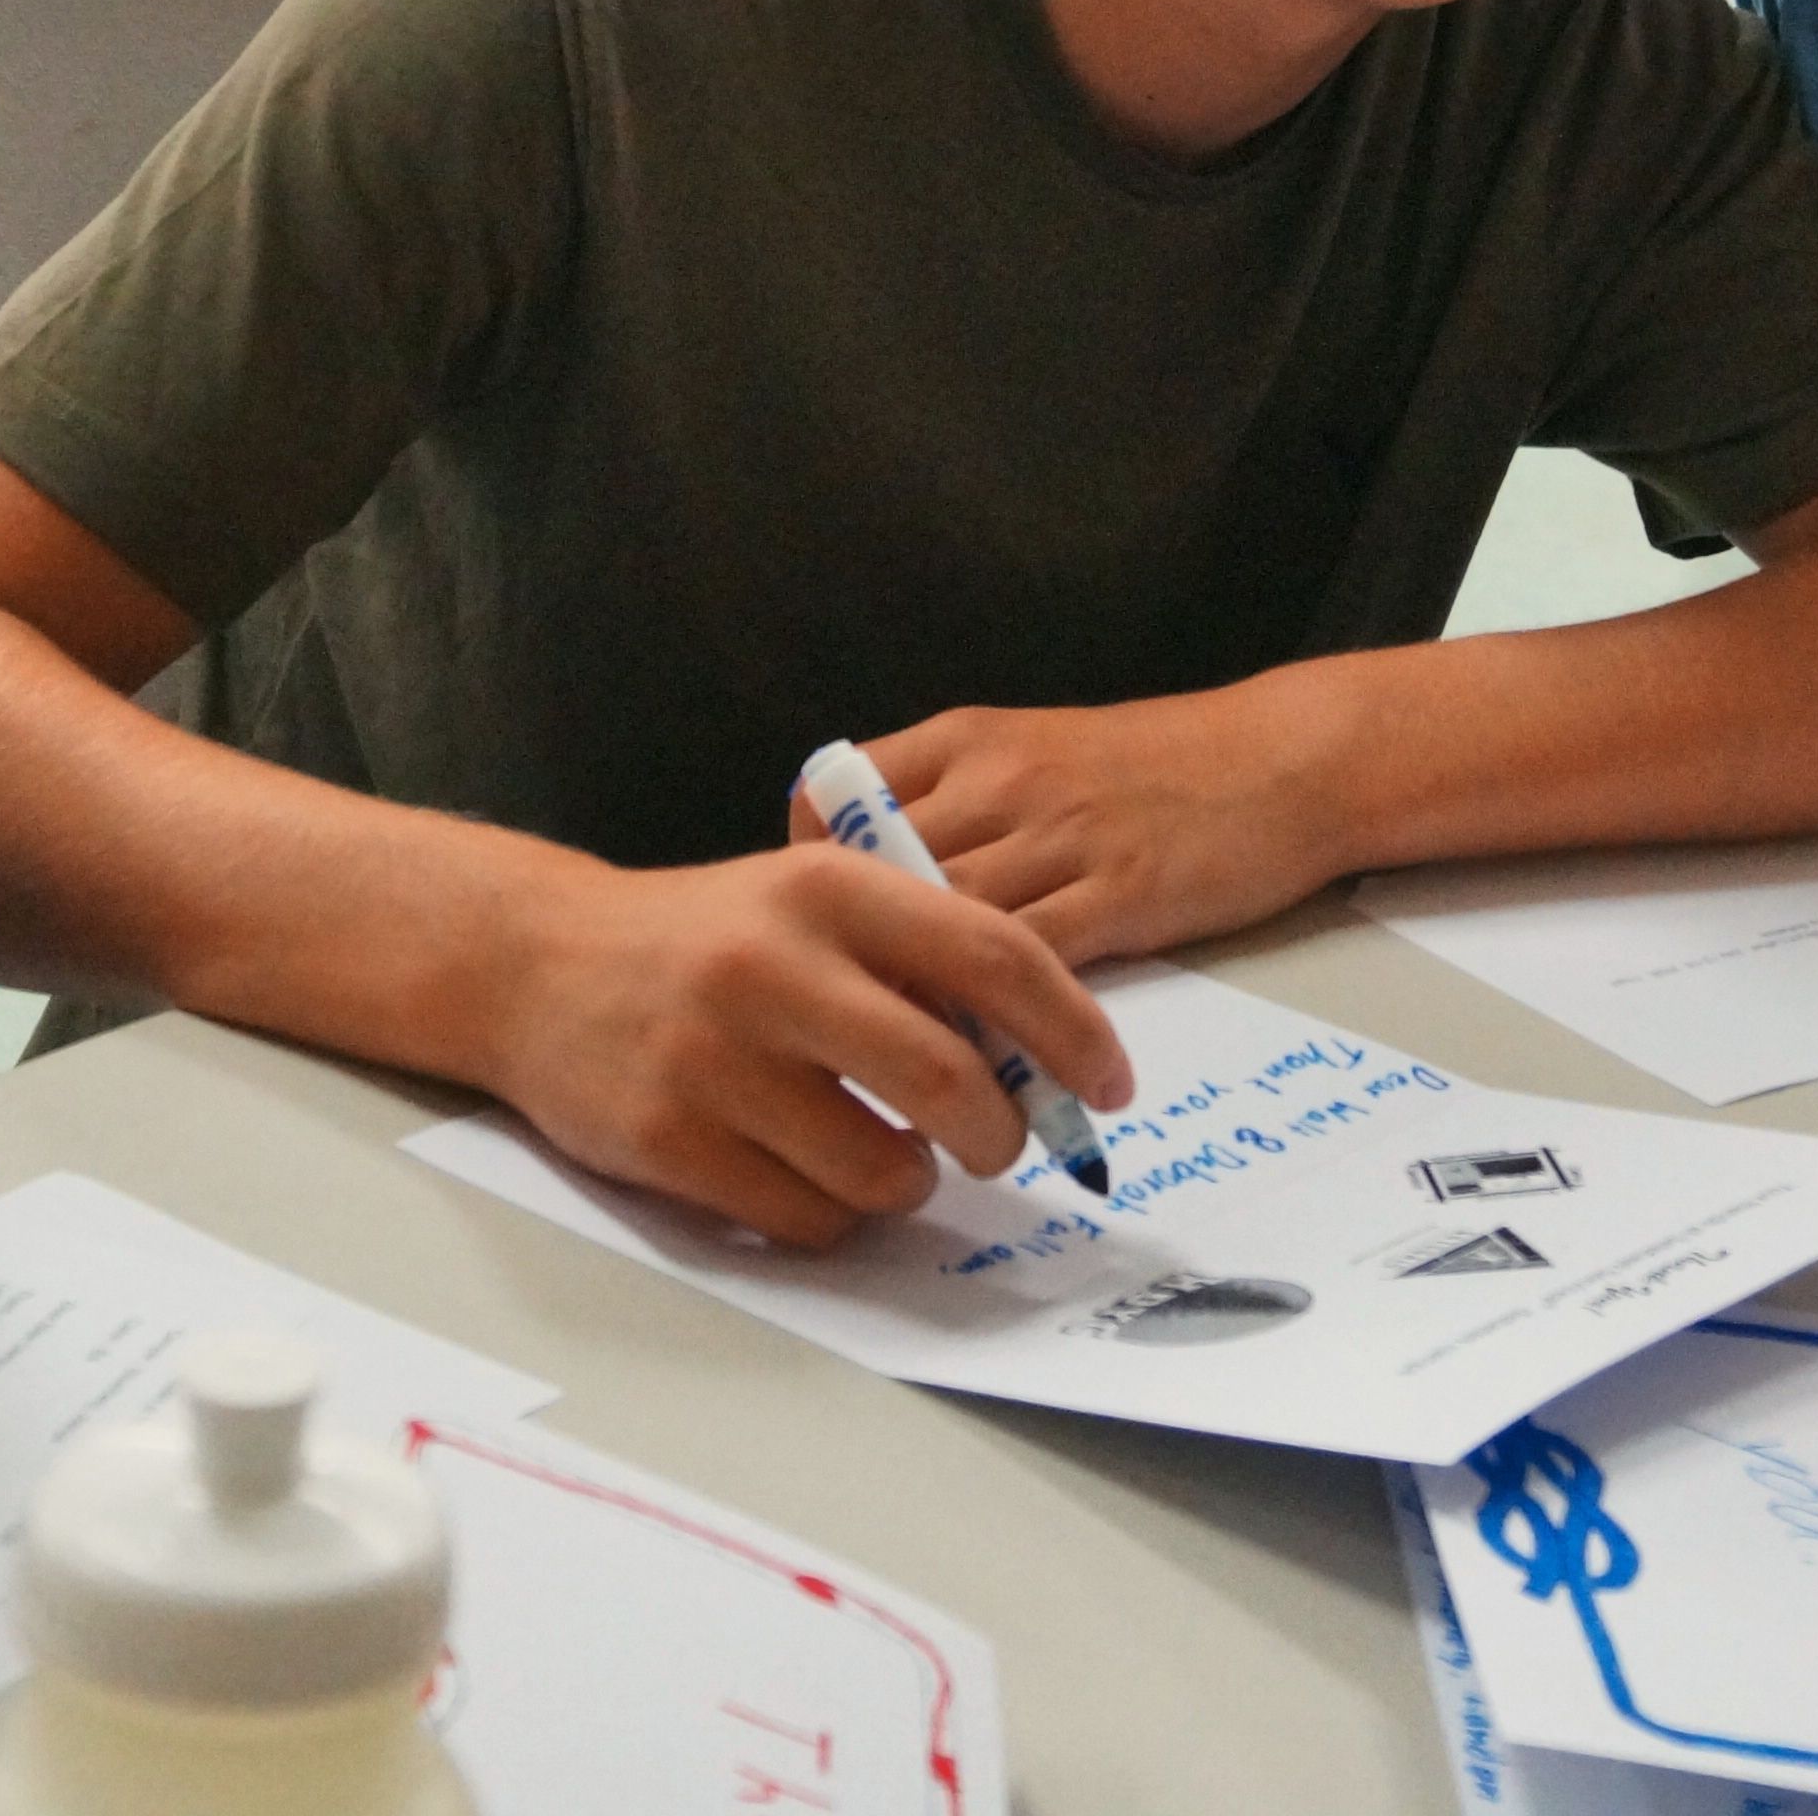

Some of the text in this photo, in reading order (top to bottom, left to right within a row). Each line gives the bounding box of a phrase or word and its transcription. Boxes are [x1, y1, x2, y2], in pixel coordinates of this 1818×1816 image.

[1246, 1038, 1366, 1096] Thank
[1364, 1064, 1451, 1101] Dear
[1162, 1079, 1234, 1119] you
[1104, 1142, 1250, 1216] Deborah
